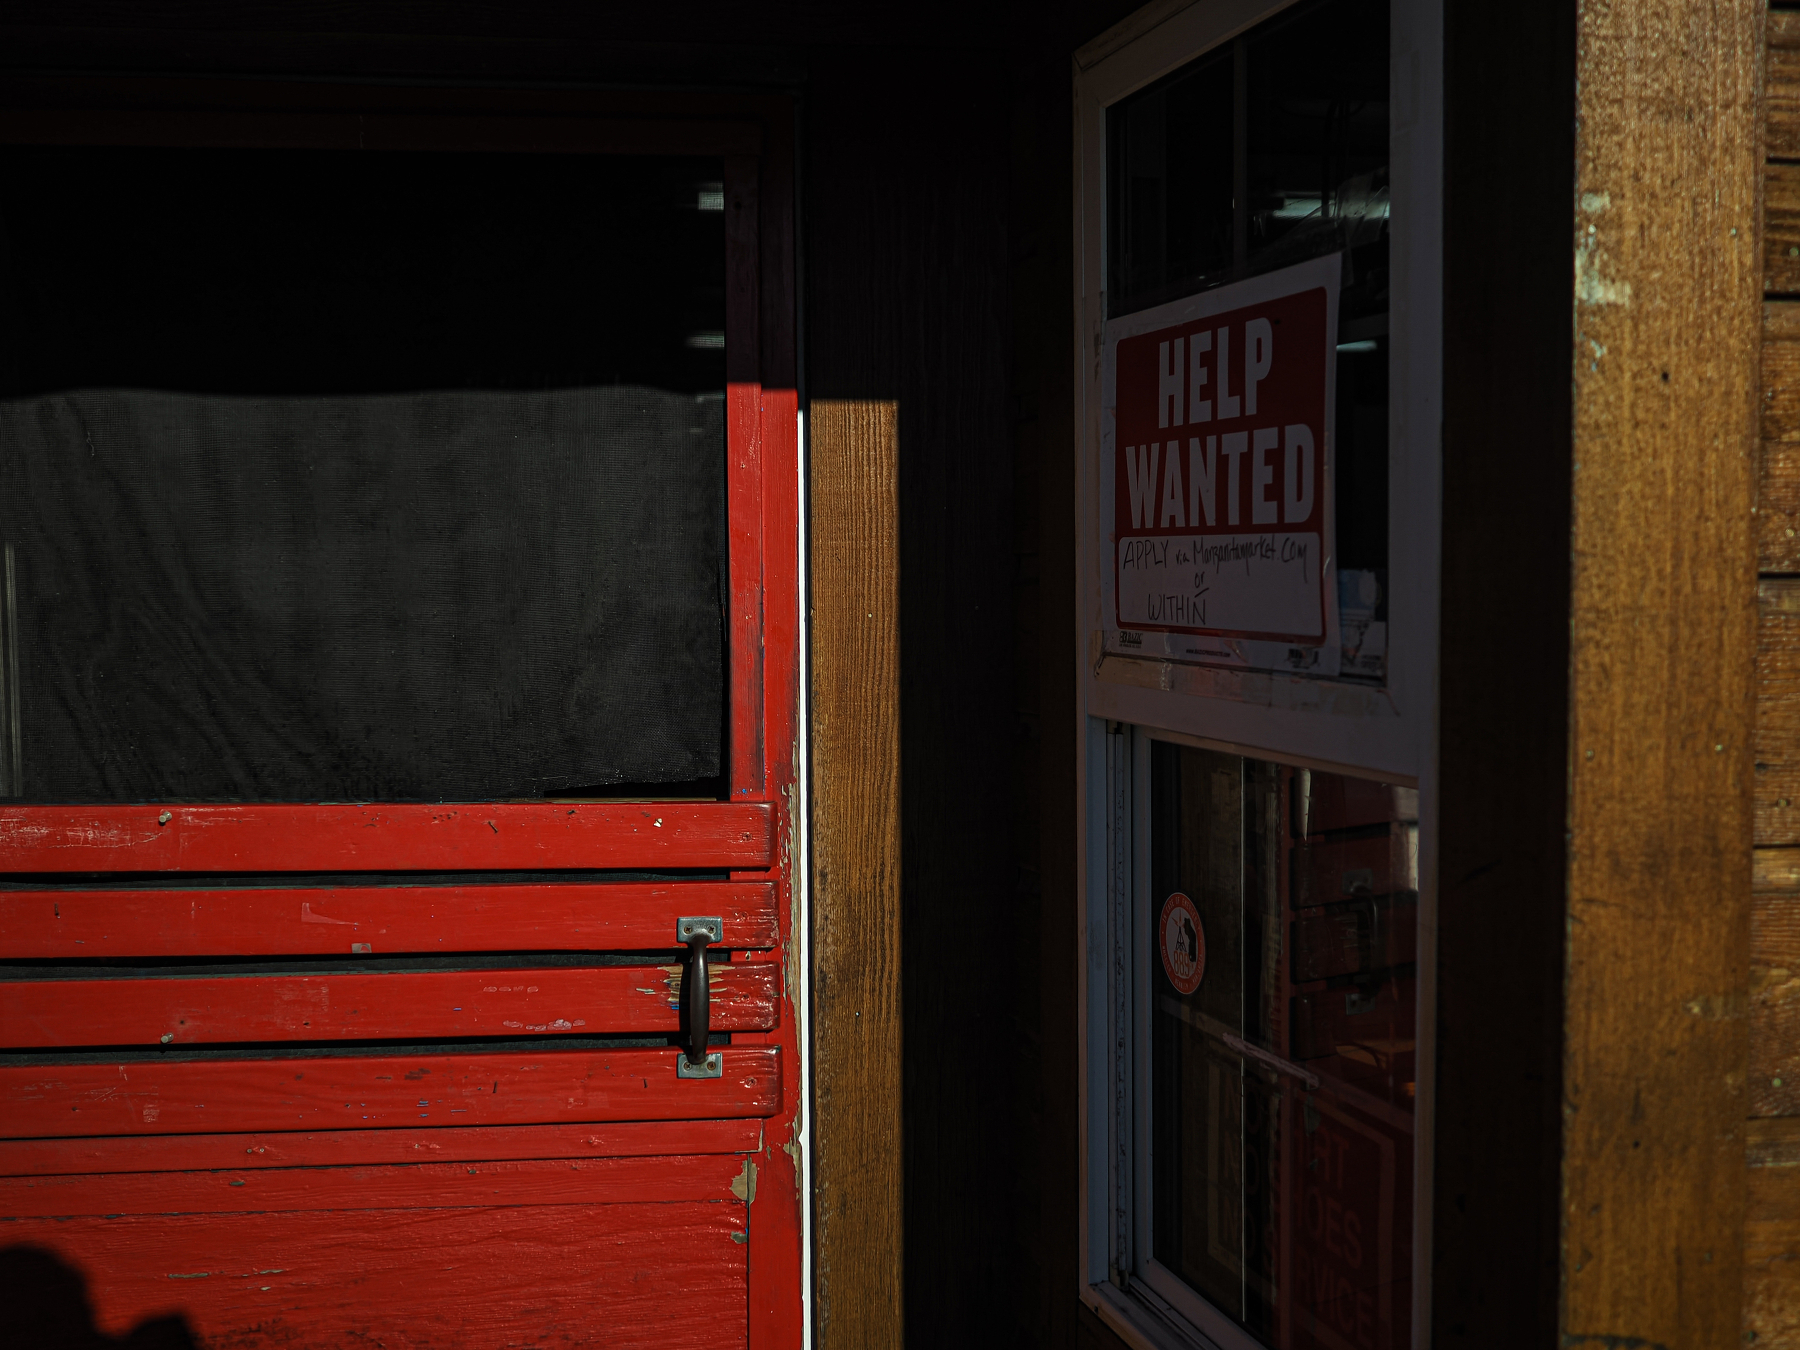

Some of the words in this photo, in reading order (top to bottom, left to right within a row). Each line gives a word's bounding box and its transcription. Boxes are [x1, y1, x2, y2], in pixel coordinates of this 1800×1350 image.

[1159, 317, 1273, 429] HELP
[1125, 423, 1315, 530] WANTED
[1123, 539, 1169, 570] APPLY
[1176, 549, 1190, 565] via
[1194, 571, 1206, 589] or
[1148, 594, 1206, 626] WITHIN
